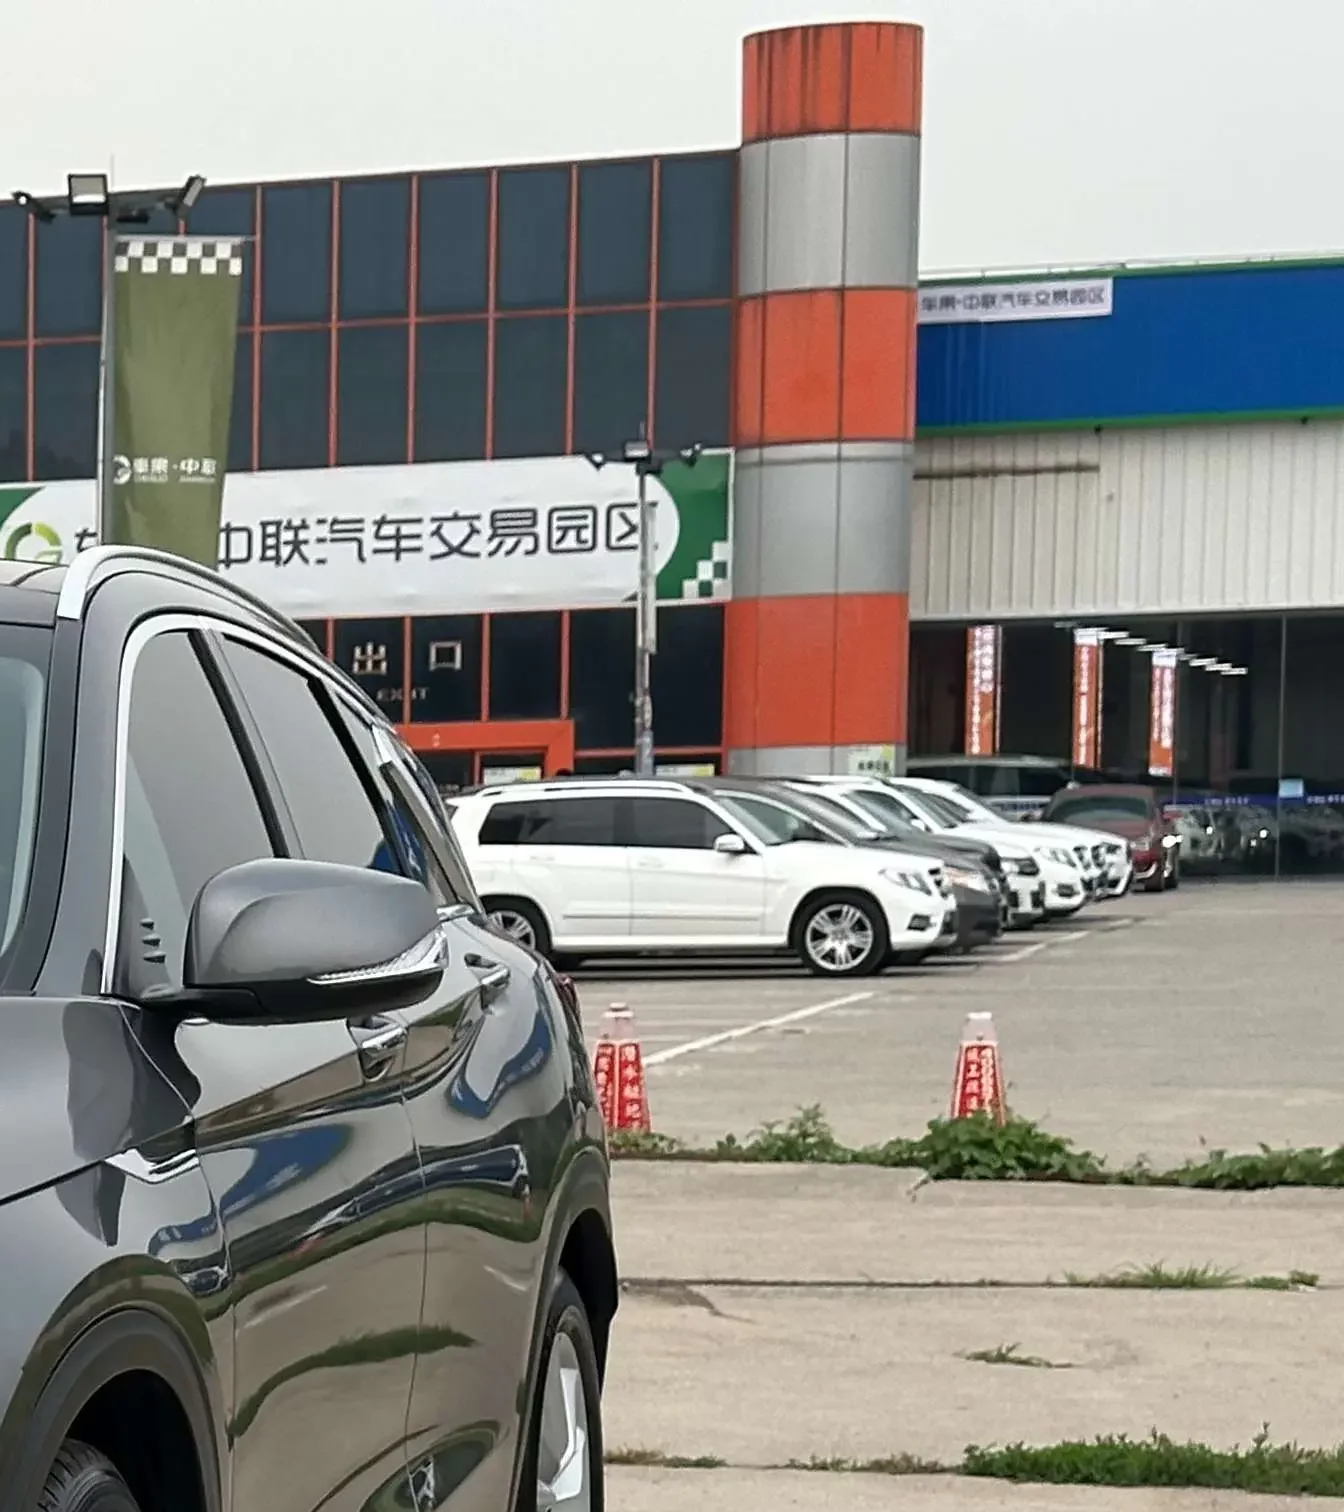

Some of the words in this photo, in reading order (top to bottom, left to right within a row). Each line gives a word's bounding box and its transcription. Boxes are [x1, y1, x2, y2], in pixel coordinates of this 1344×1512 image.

[74, 501, 659, 568] 中联汽车交易园区
[352, 640, 463, 676] 出口
